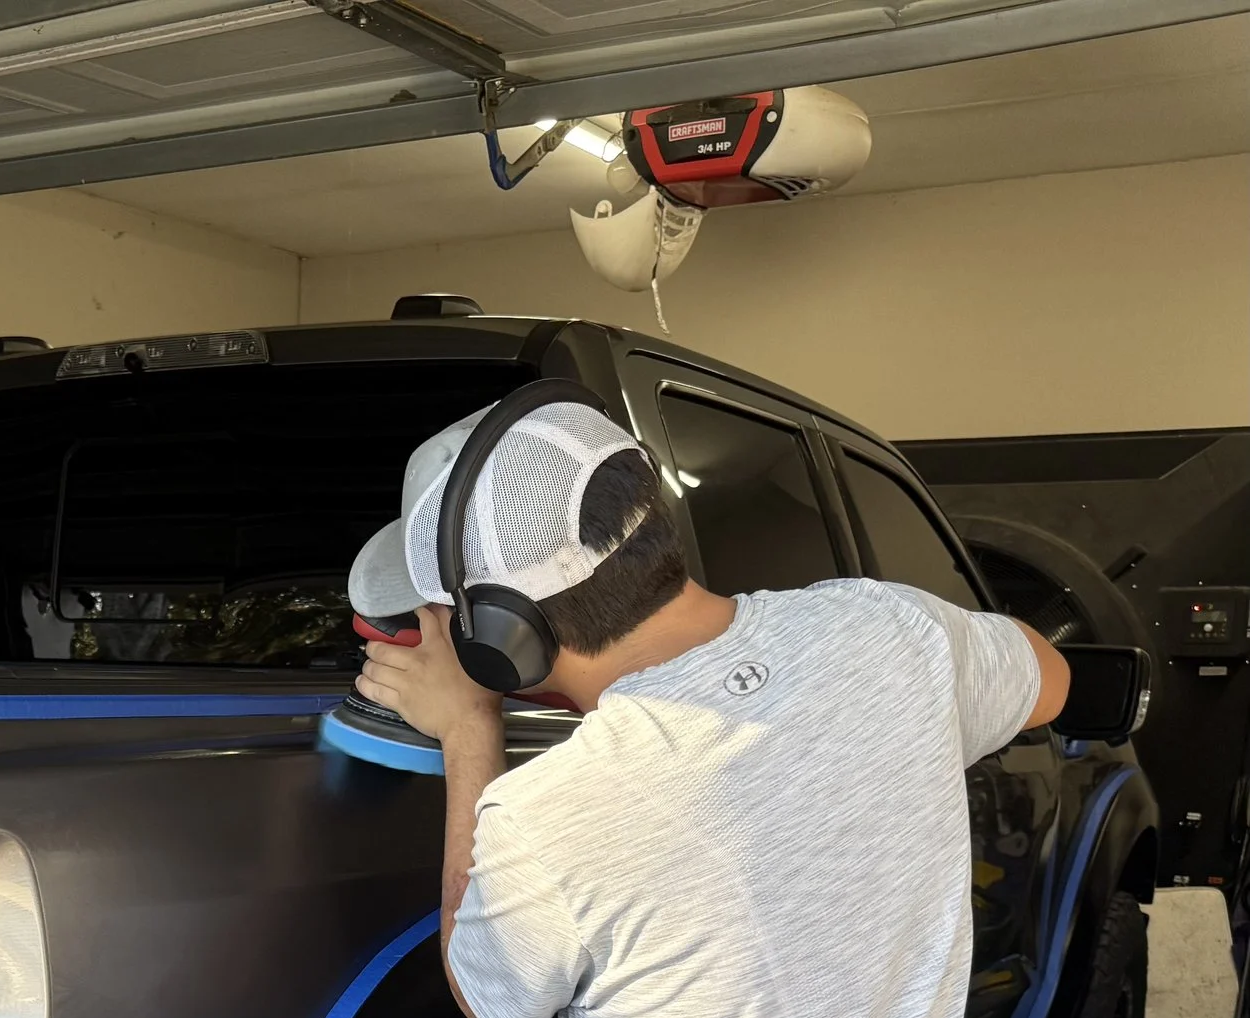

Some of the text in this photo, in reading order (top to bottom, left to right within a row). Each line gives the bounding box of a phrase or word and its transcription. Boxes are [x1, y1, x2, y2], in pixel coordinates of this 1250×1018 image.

[671, 121, 722, 138] CRAFTSMAN
[697, 141, 732, 154] 3/4 HP
